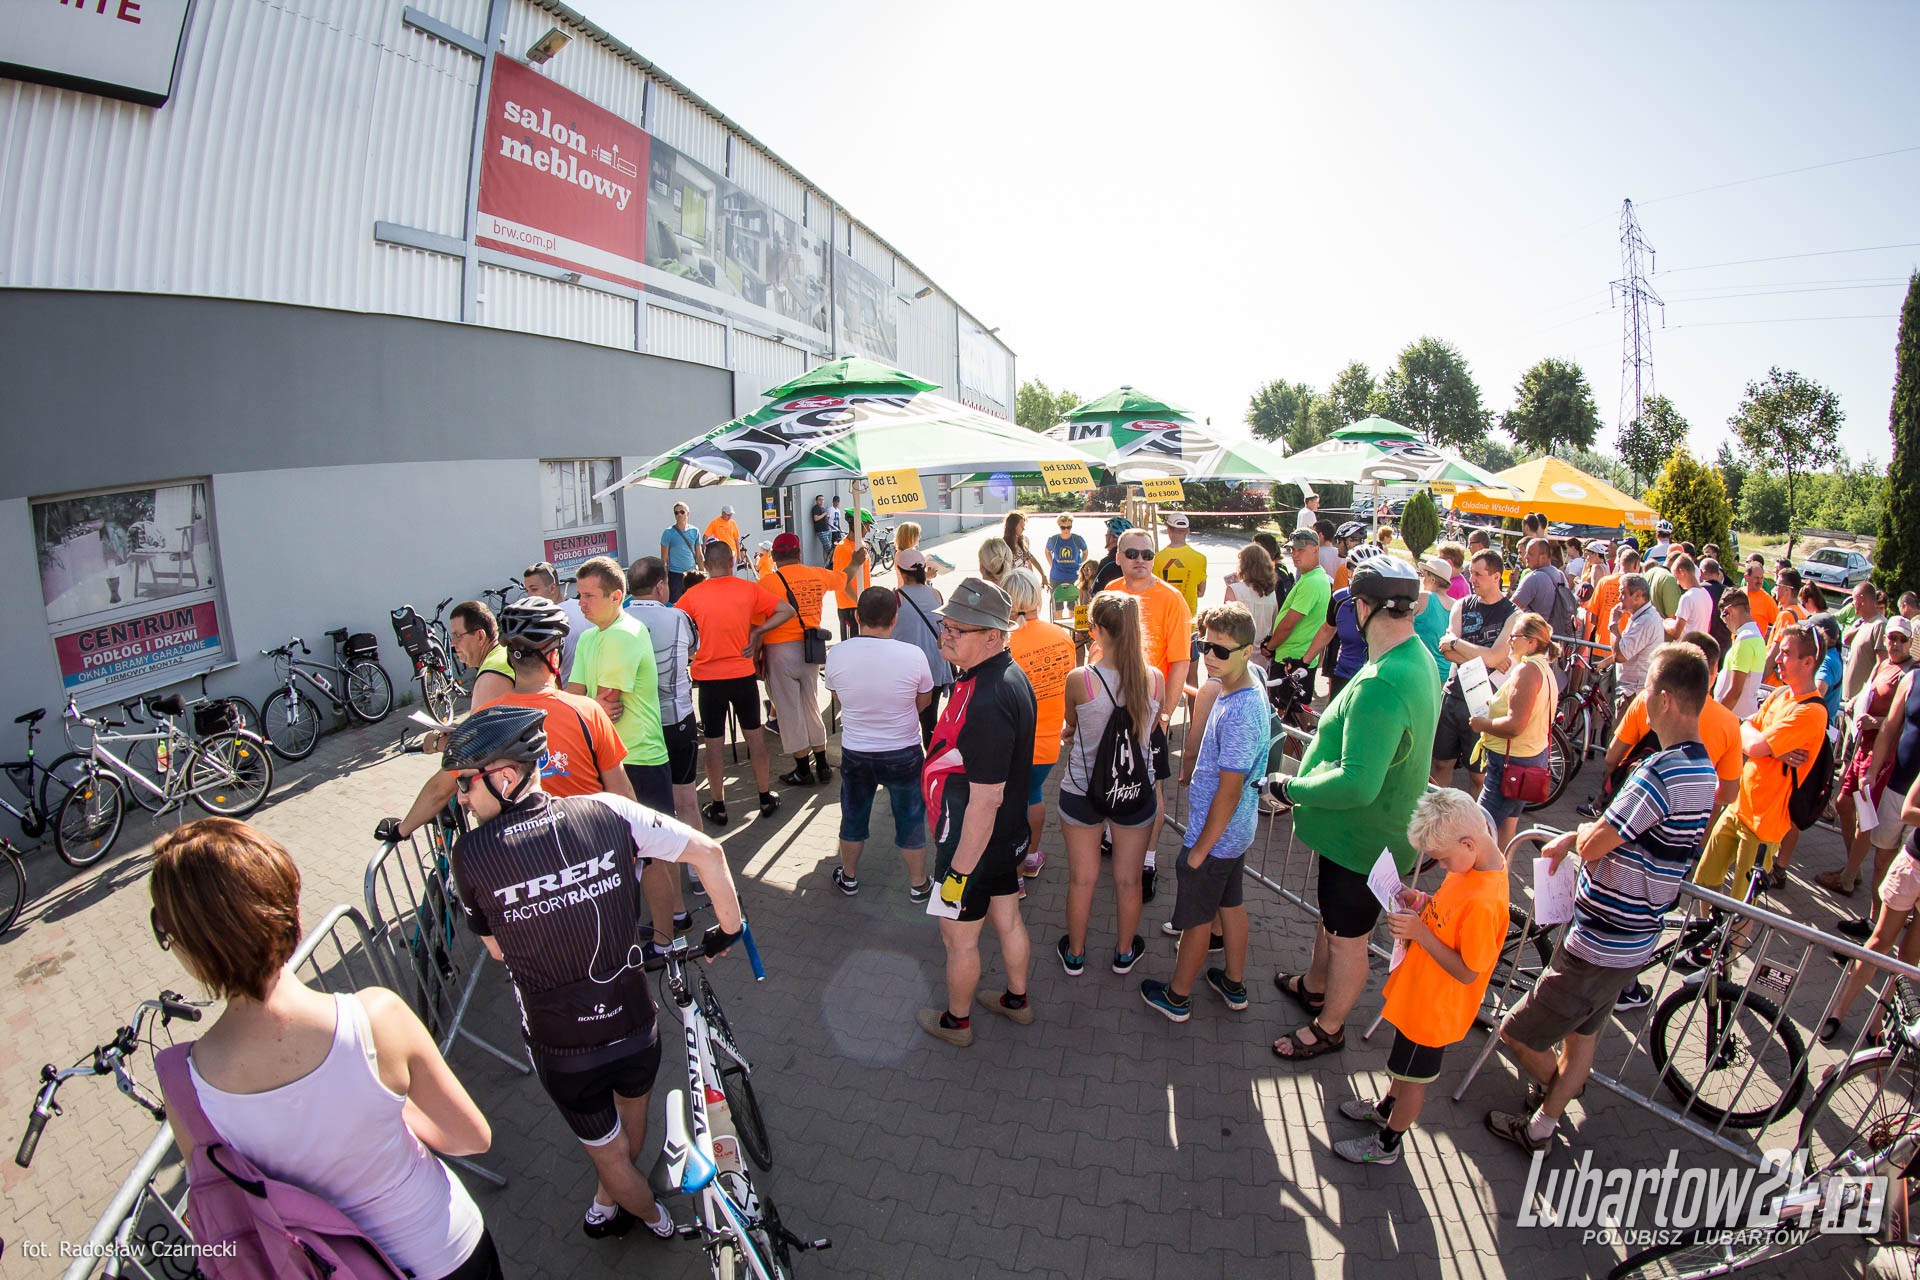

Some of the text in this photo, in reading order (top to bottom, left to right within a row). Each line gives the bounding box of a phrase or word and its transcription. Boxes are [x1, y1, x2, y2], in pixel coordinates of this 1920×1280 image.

[504, 101, 587, 155] salon
[500, 136, 631, 211] meblowy
[493, 219, 556, 251] brw.com.pl
[872, 475, 897, 486] od E1
[1044, 463, 1082, 472] od E1001
[1050, 476, 1088, 487] do E2000
[877, 492, 919, 506] do E1000
[553, 533, 607, 551] CENTRUM
[554, 549, 583, 561] PODŁOG
[588, 545, 608, 556] DRZWI
[78, 607, 195, 651] CENTRUM
[78, 667, 107, 682] OKNA
[116, 656, 149, 671] BRAMY
[152, 640, 206, 662] GARAŻOWE
[83, 629, 198, 669] PODŁOG I DRZWI
[105, 656, 184, 684] FIRMOWY MONTAŻ
[504, 811, 566, 836] SHIMANO
[494, 849, 616, 906] TREK
[1768, 968, 1792, 983] SLS
[577, 1005, 623, 1022] BONTRAGER
[685, 1026, 709, 1136] VENTO
